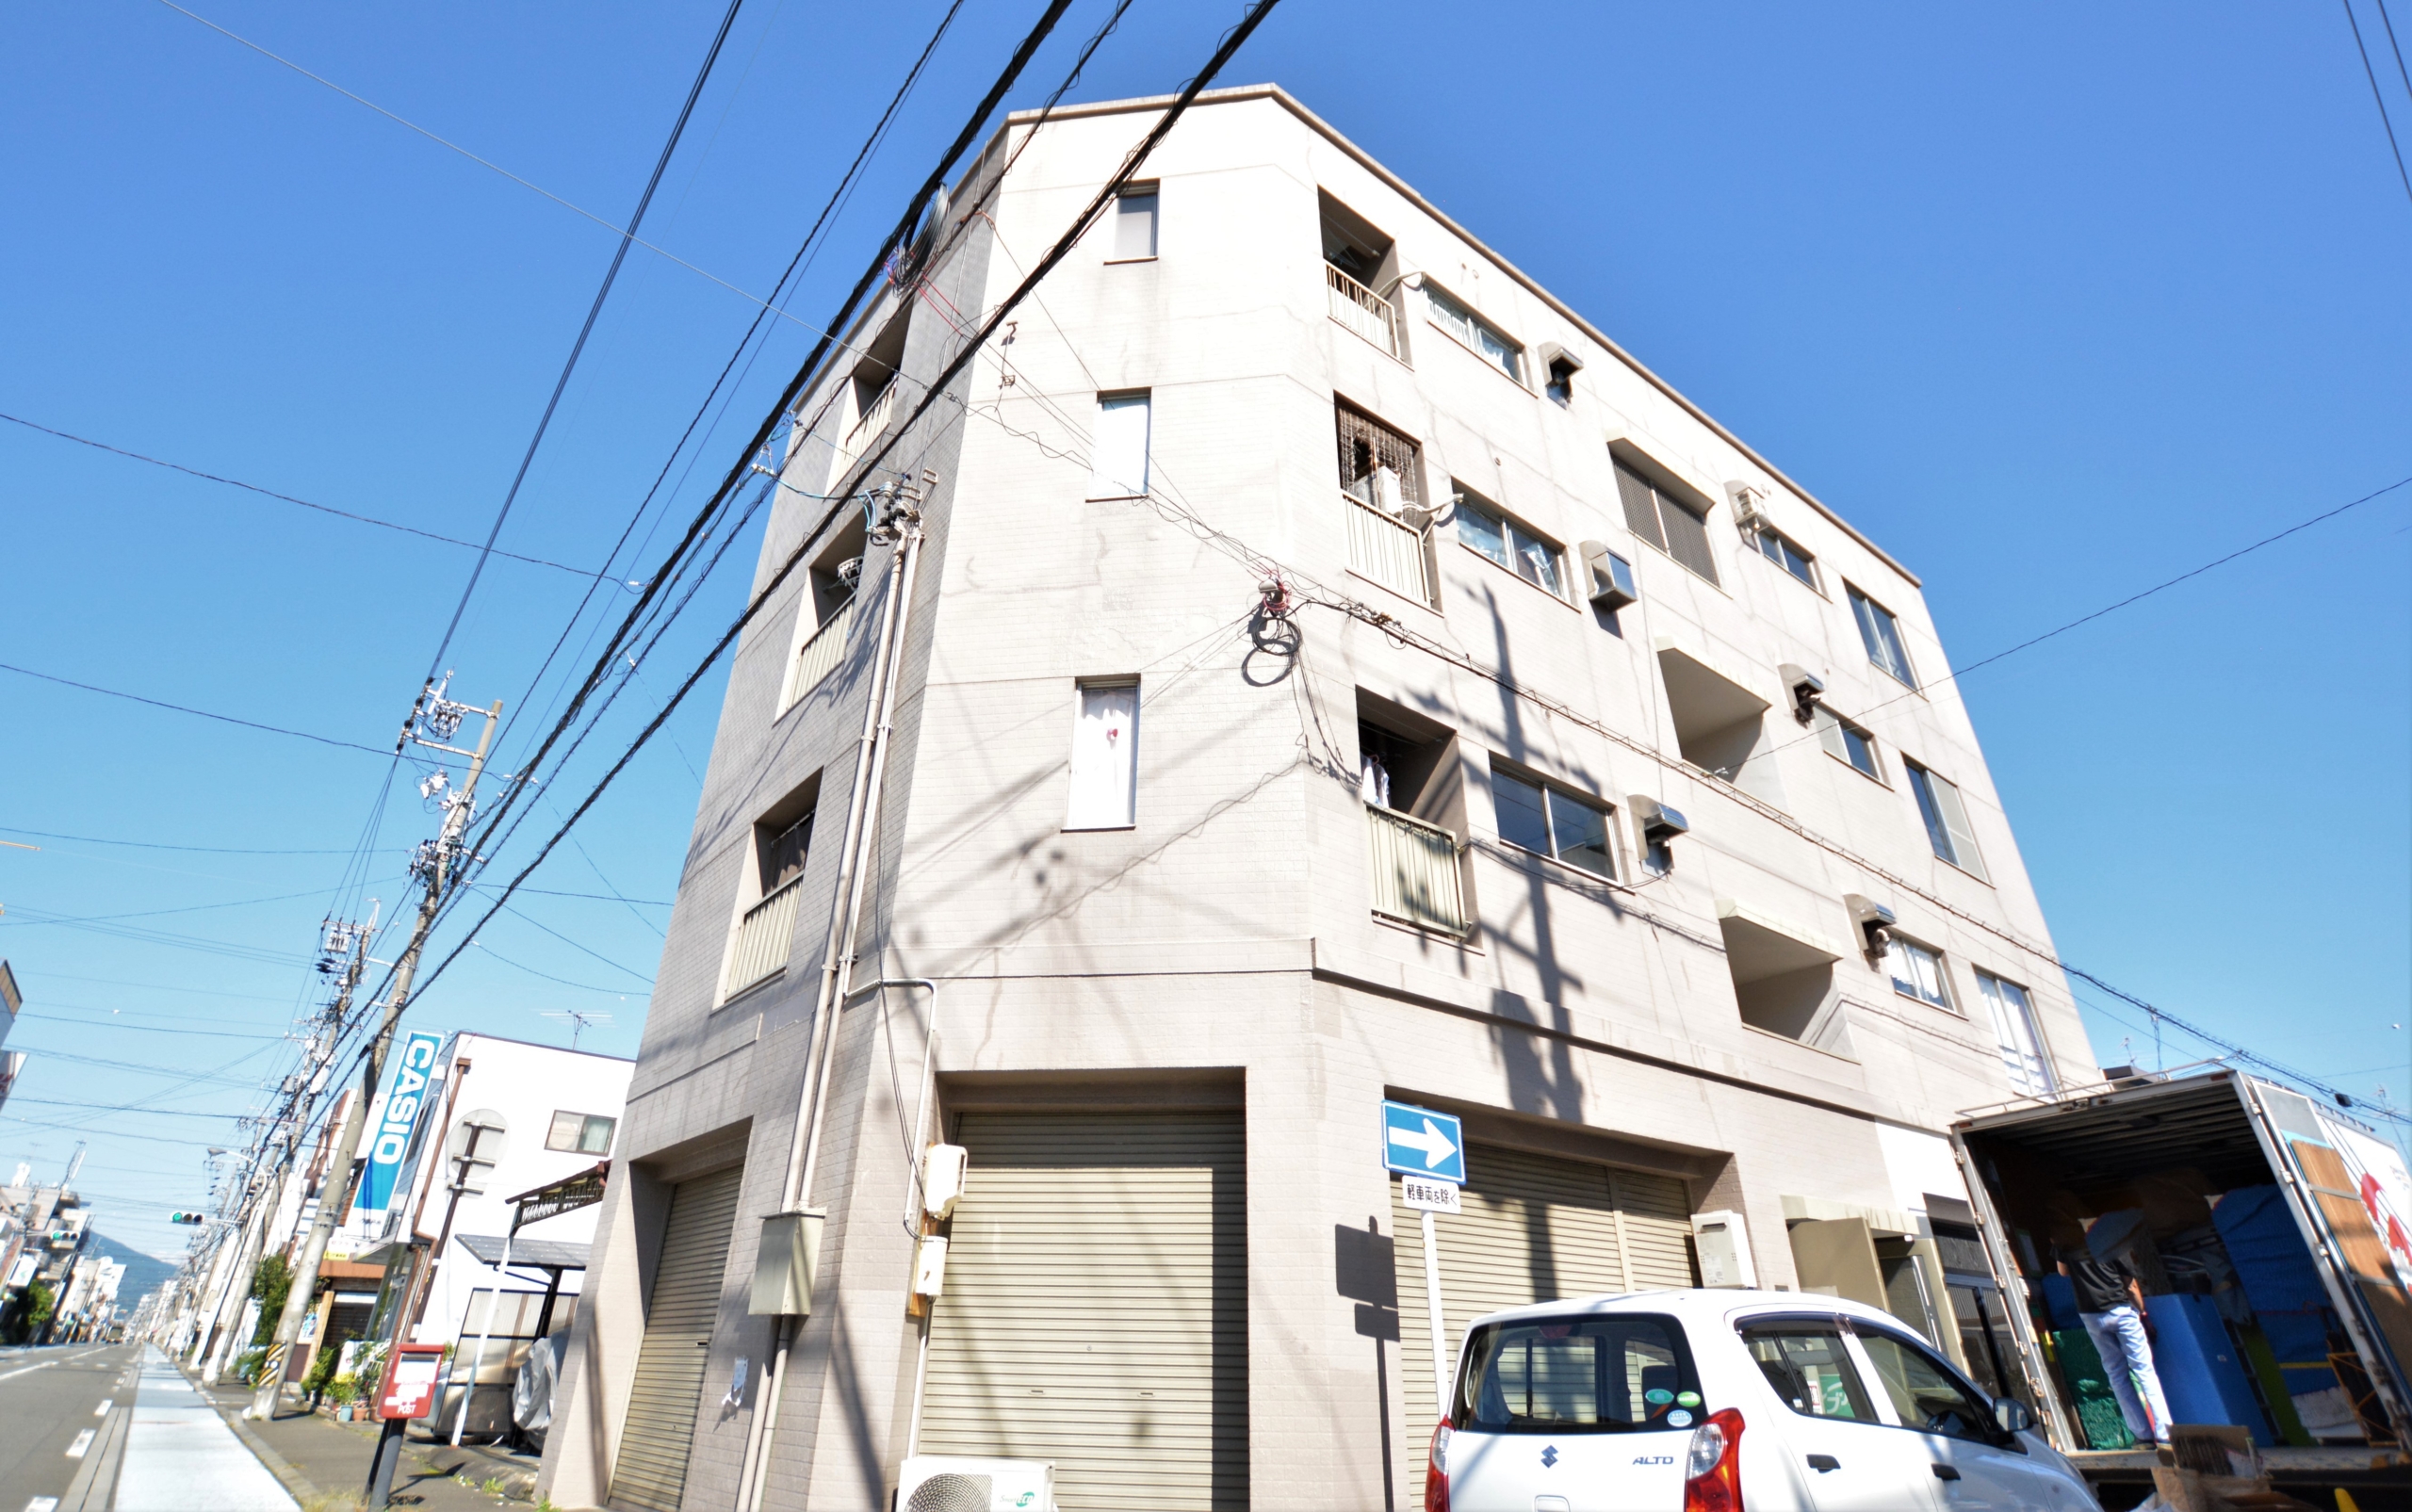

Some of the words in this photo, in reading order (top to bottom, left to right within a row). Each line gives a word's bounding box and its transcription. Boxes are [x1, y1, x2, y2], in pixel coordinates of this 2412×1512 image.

[373, 1039, 435, 1164] CASIO
[1407, 1183, 1458, 1206] 軽車両を除く
[397, 1405, 416, 1415] POST
[1632, 1456, 1674, 1465] ALTO
